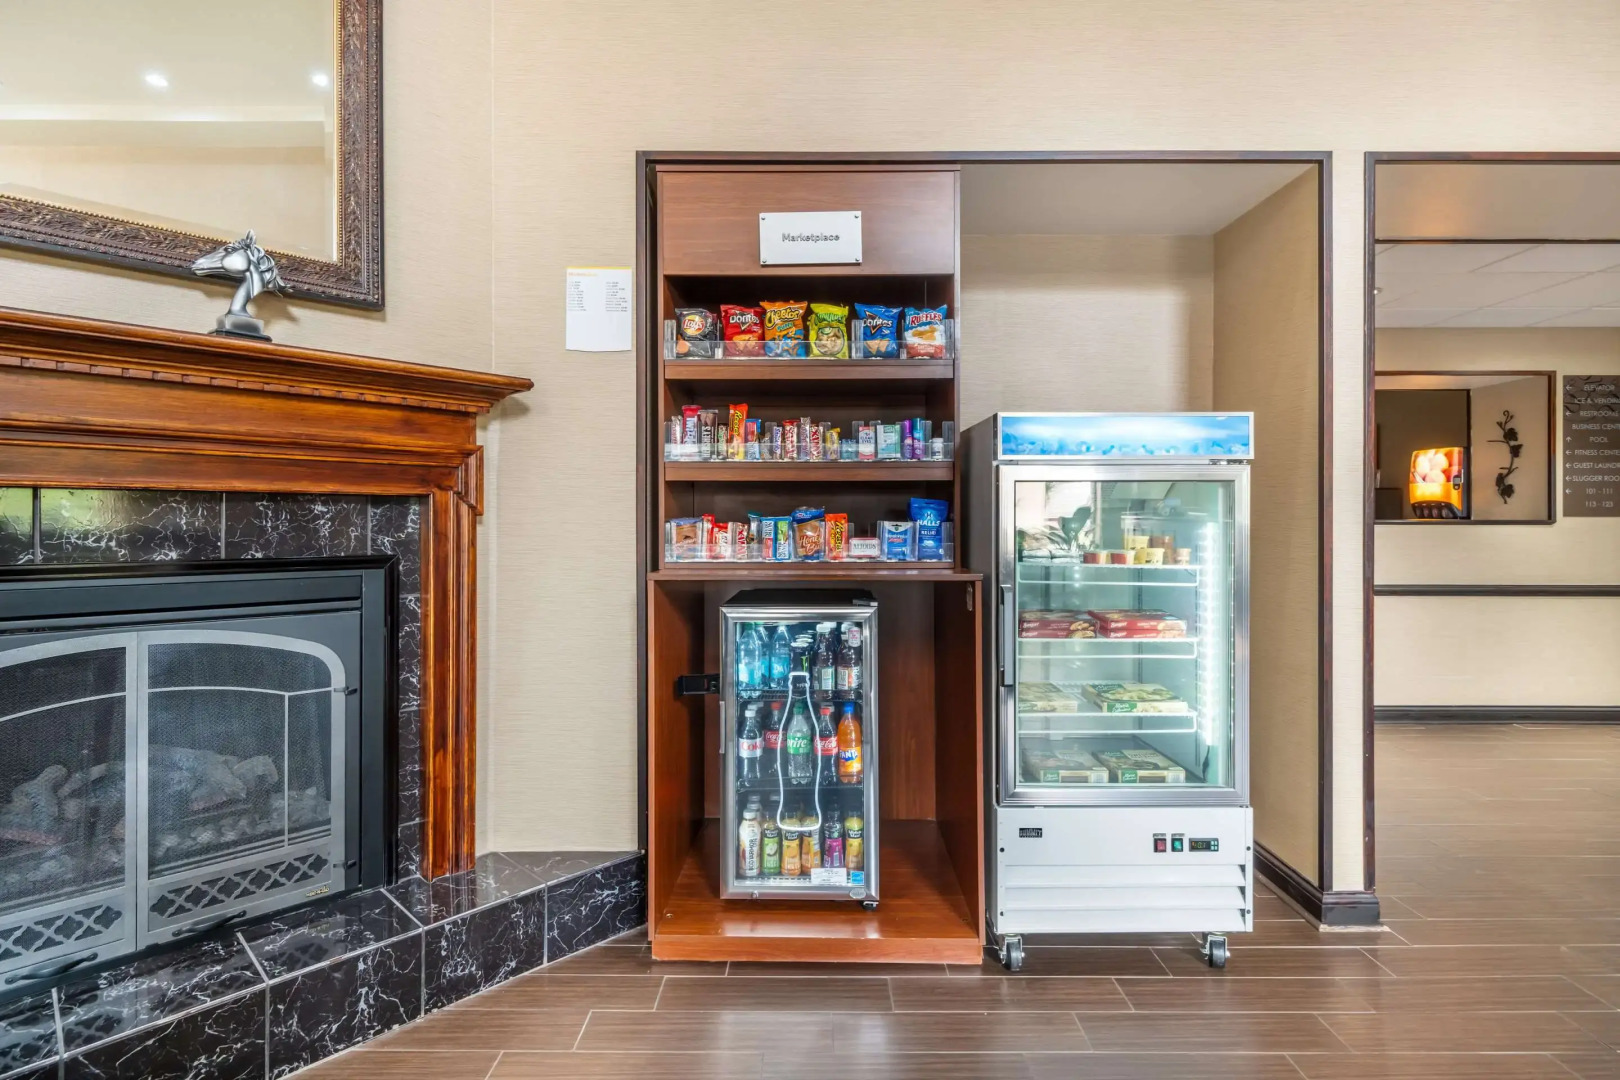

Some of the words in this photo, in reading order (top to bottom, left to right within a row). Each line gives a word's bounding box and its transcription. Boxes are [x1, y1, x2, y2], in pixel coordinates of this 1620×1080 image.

[781, 232, 840, 243] Marketplace
[729, 313, 760, 324] Doritos
[764, 307, 801, 328] Cheetos
[862, 317, 893, 328] Doritos
[910, 311, 942, 326] RUFFLES
[702, 426, 712, 458] HERSHEY'S
[1602, 500, 1614, 508] 123
[917, 519, 941, 527] HALLS
[787, 737, 807, 748] rite
